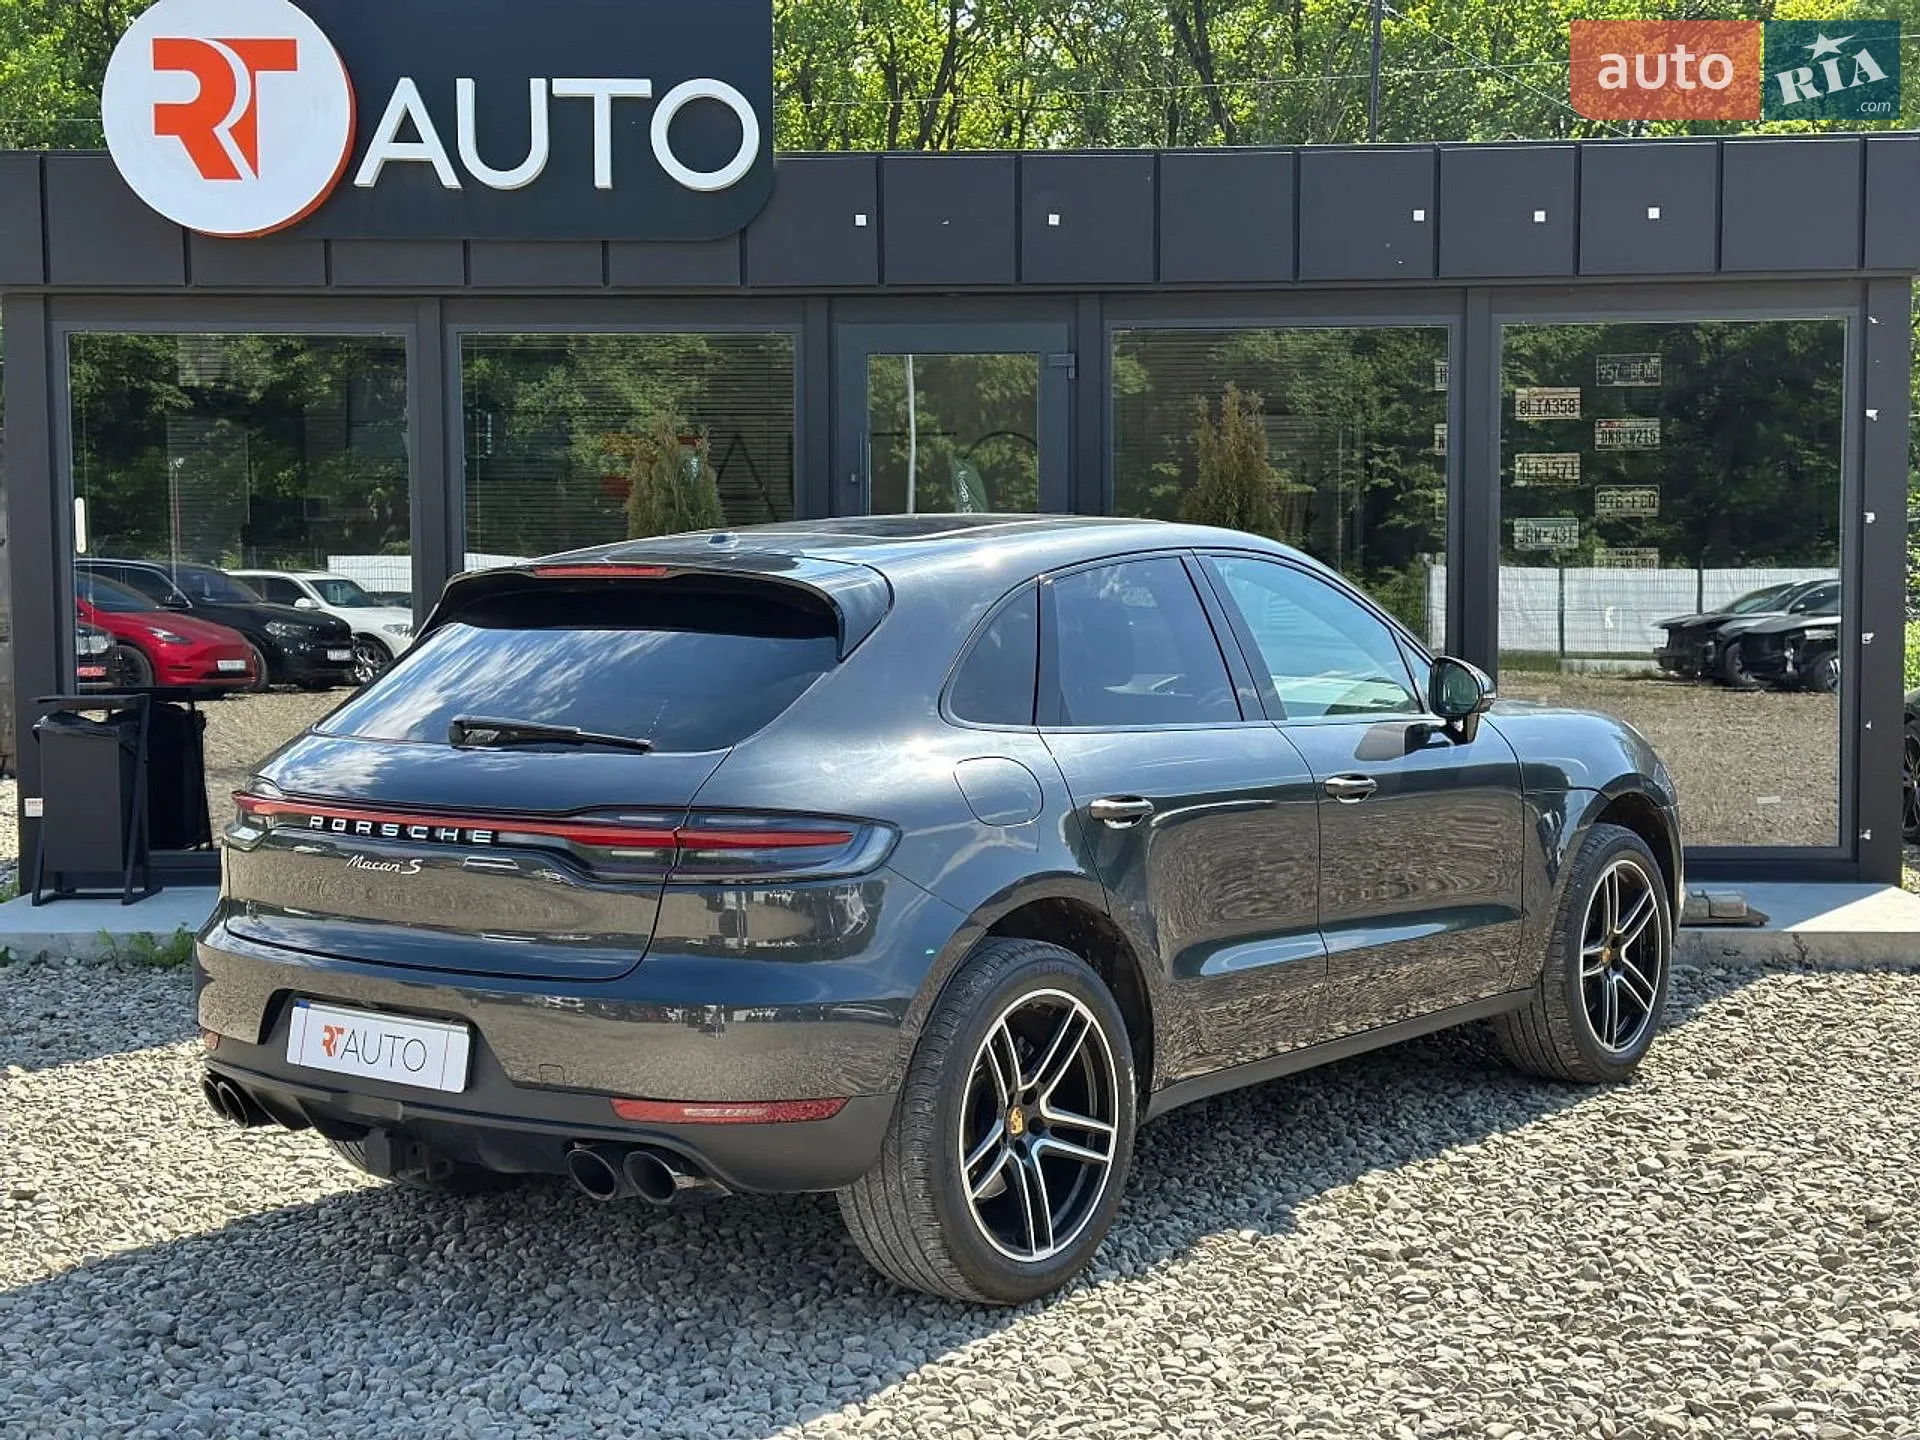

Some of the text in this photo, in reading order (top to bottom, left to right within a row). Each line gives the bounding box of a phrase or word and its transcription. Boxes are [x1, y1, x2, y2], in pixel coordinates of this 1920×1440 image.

[152, 37, 761, 191] RT AUTO
[309, 815, 493, 844] PORSCHE
[346, 855, 424, 875] Macan S
[340, 1028, 427, 1072] AUTO
